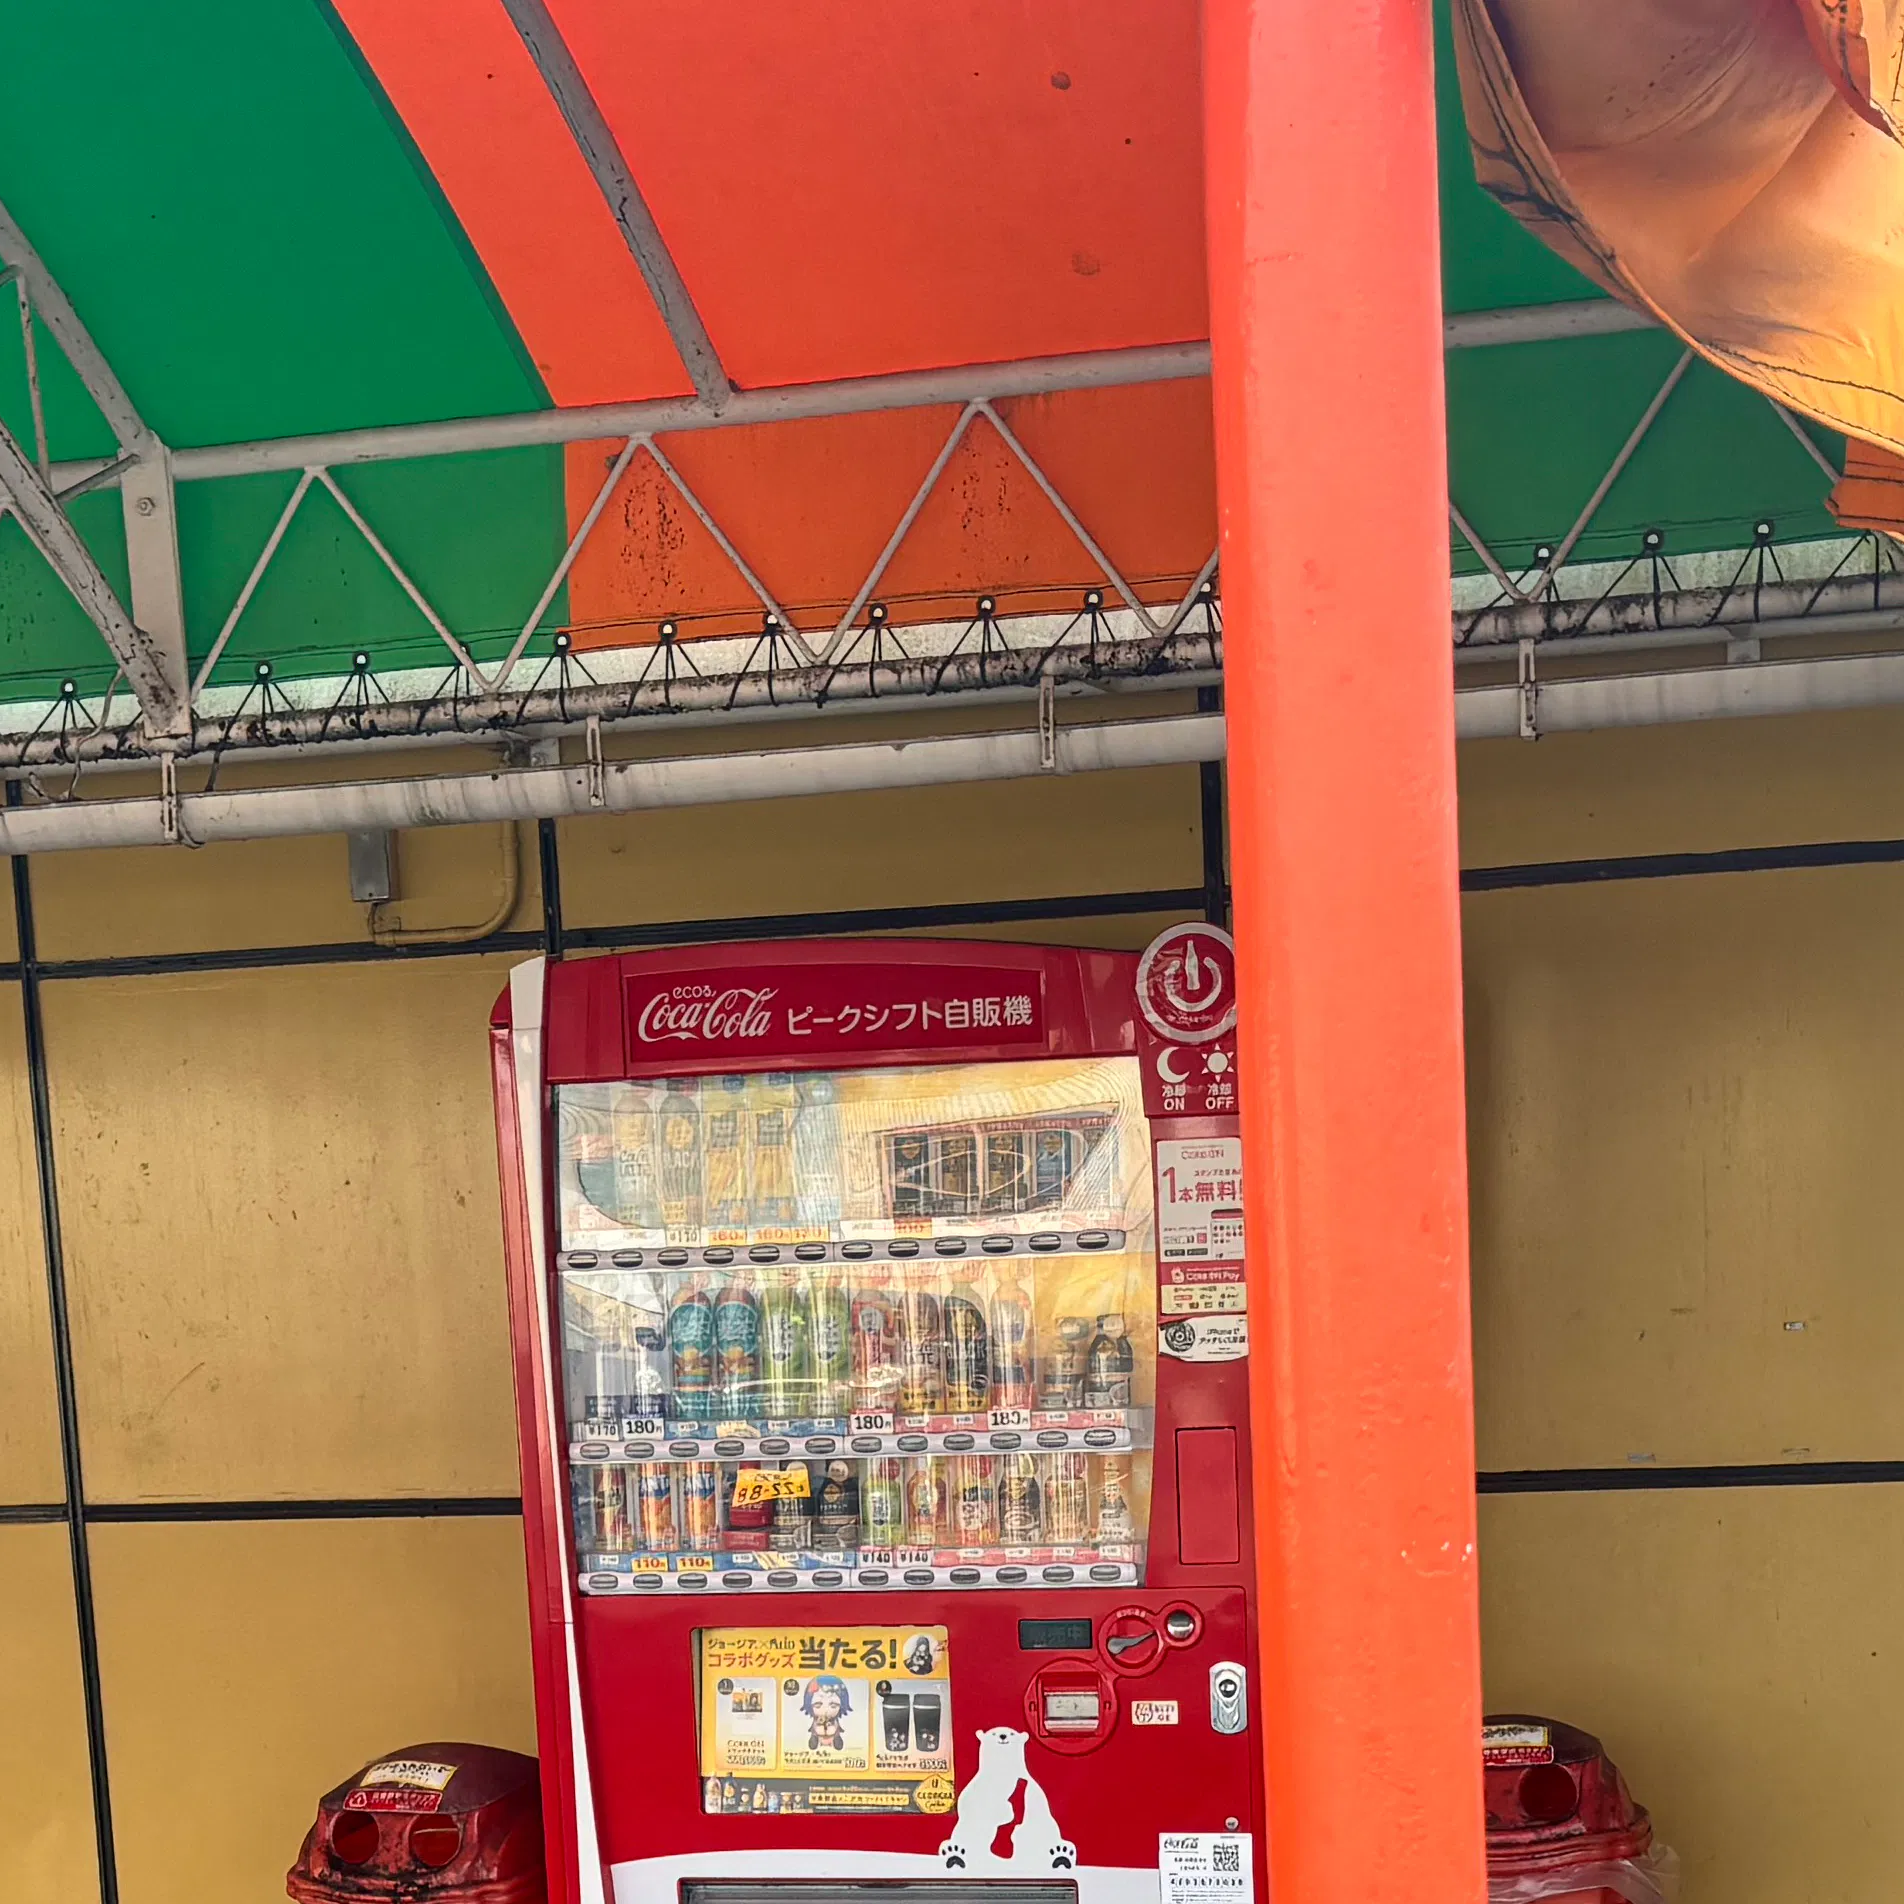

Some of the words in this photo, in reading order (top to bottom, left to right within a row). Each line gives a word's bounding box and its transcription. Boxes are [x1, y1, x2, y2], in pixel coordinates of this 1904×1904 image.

[637, 986, 781, 1043] Coca-Cola
[787, 996, 1034, 1036] ピークシフト自販機
[1163, 1097, 1185, 1111] ON
[1205, 1096, 1235, 1110] OFF
[708, 1652, 796, 1669] コラボグッズ
[798, 1635, 897, 1671] 当たる!
